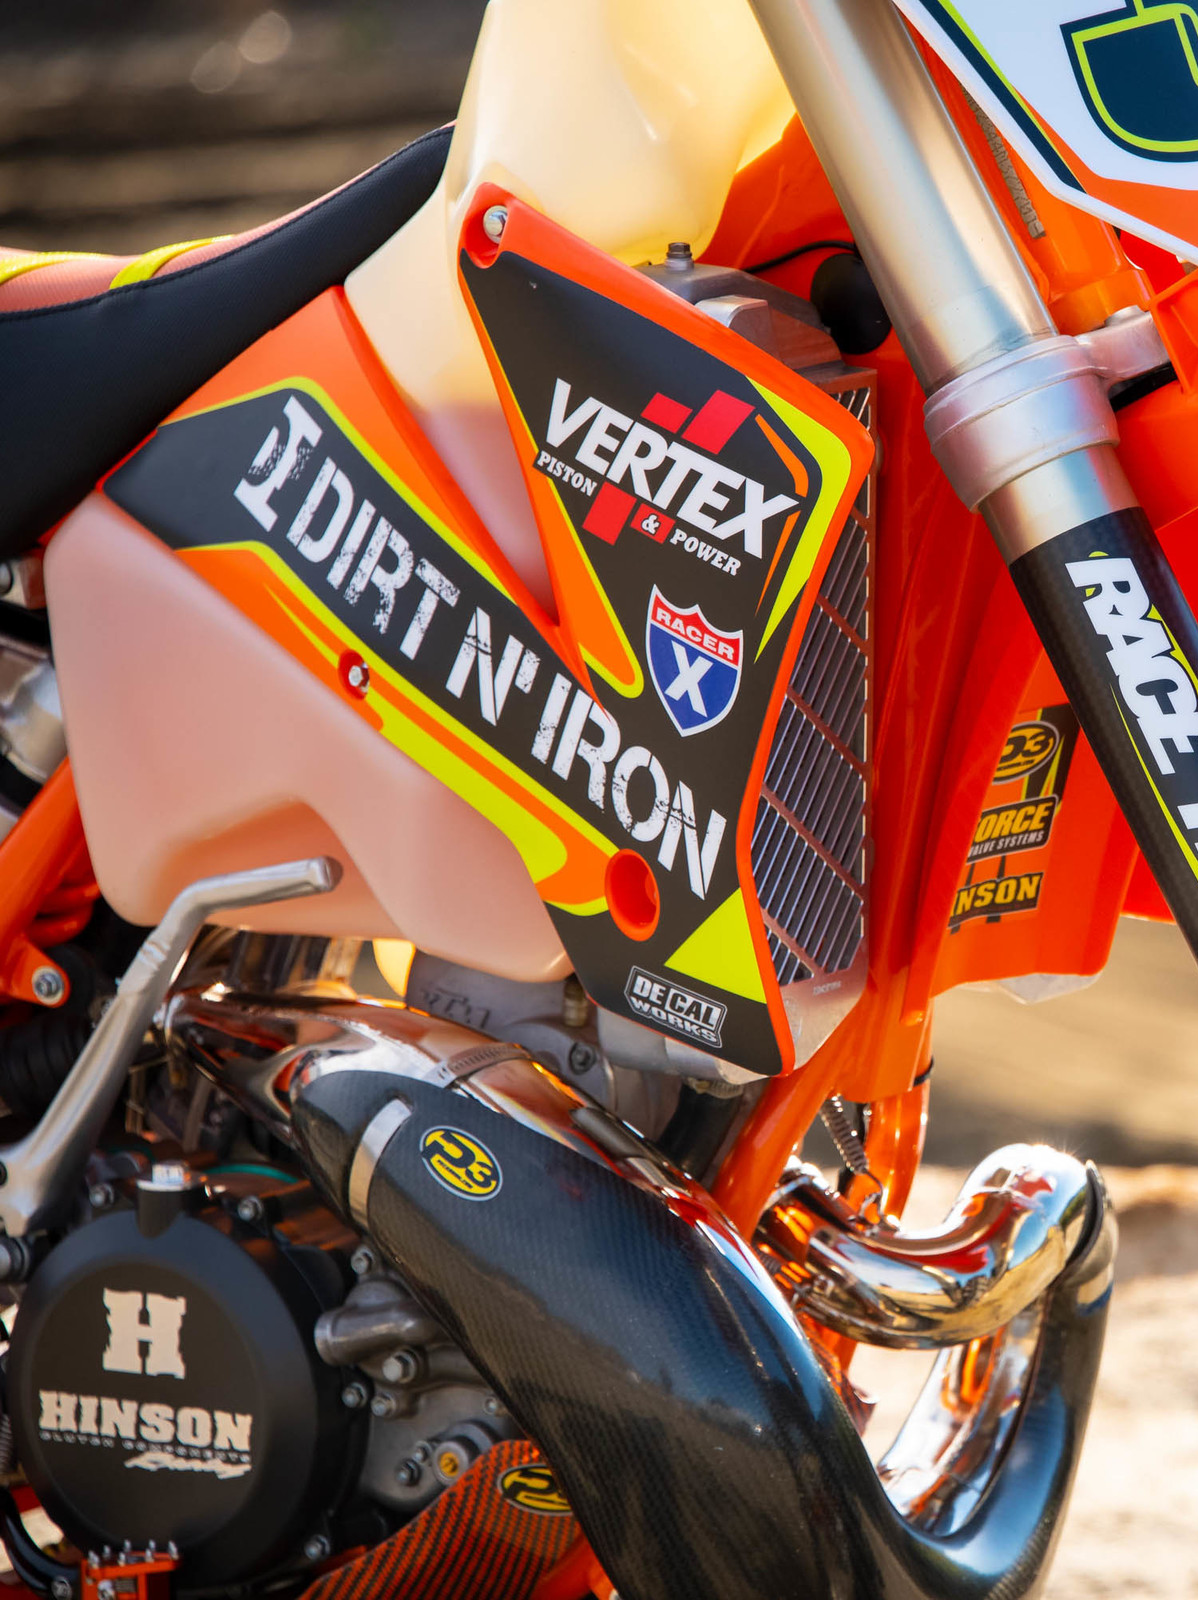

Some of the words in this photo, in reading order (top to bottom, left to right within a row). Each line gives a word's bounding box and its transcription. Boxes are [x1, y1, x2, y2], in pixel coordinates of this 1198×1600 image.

[546, 377, 800, 560] VERTEX
[536, 450, 598, 498] PISTON
[641, 513, 660, 535] &
[669, 527, 742, 576] POWER
[655, 606, 735, 661] RACER
[286, 456, 461, 661] DIRT
[531, 672, 727, 901] IRON
[664, 640, 714, 718] X
[974, 802, 1054, 843] ORCE
[997, 830, 1045, 851] SYSTEMS
[955, 875, 1041, 916] NSON
[629, 996, 717, 1043] WORKS
[102, 1286, 187, 1380] H
[38, 1389, 253, 1452] HINSON
